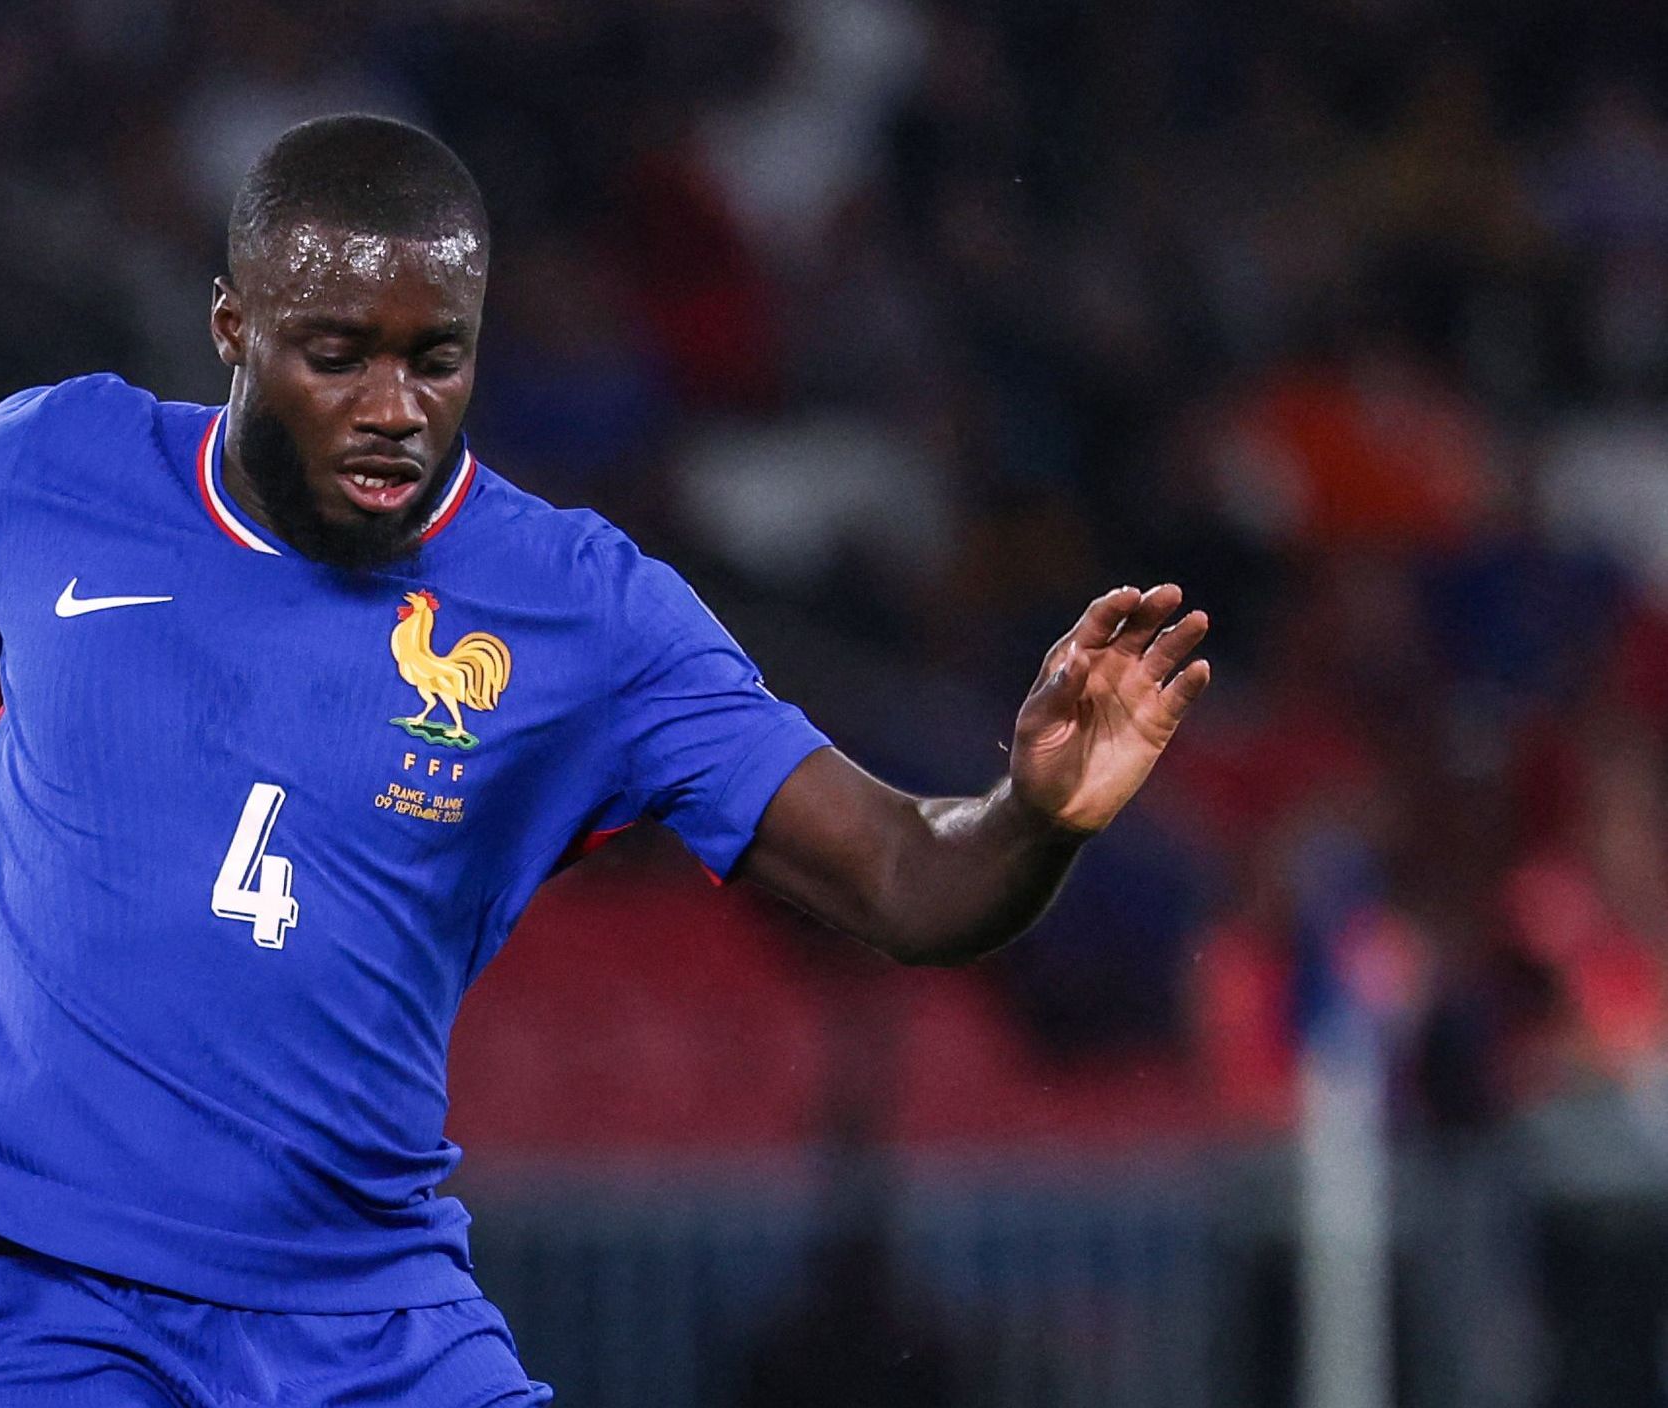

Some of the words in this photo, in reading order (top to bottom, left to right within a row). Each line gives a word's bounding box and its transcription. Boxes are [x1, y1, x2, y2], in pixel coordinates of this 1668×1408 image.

[374, 793, 393, 810] 09
[388, 782, 426, 805] FRANCE
[211, 782, 299, 950] 4
